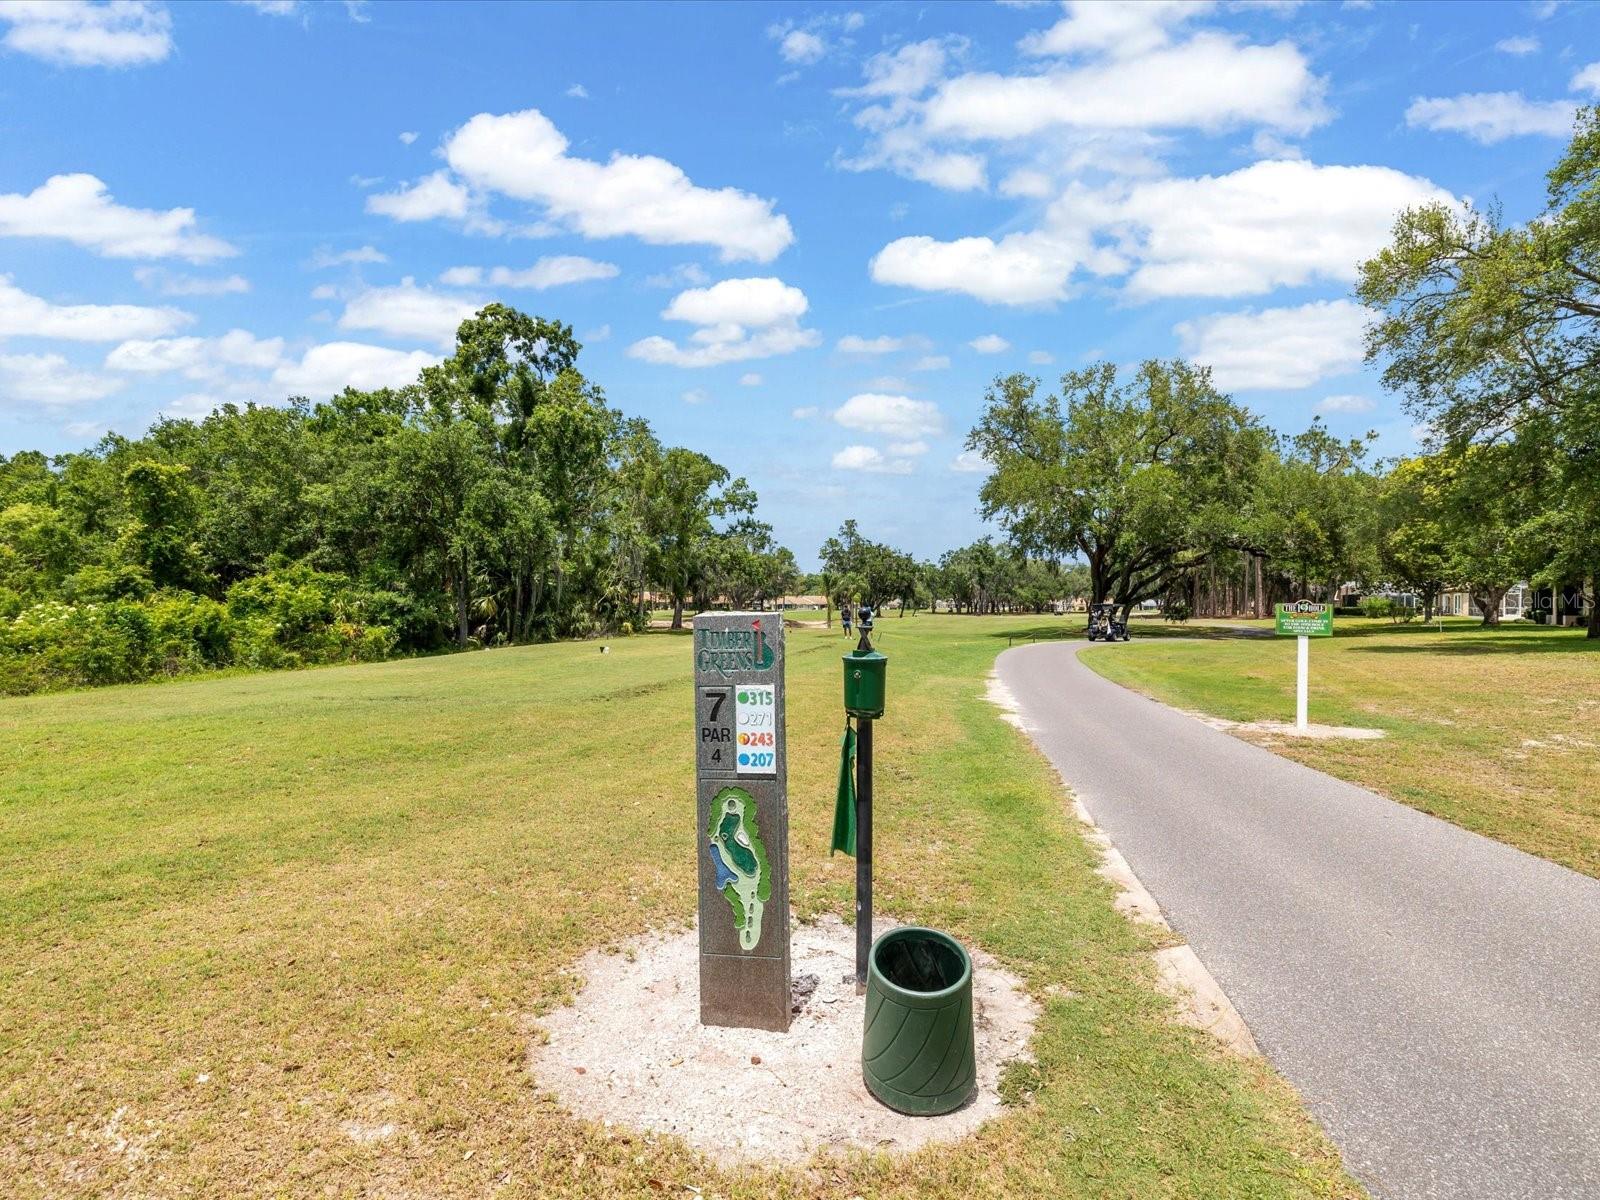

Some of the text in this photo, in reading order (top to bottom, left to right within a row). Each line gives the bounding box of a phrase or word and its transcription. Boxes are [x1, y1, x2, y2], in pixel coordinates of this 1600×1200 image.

[696, 629, 751, 649] TIMBER
[697, 650, 752, 677] GREENS
[749, 692, 773, 705] 315
[705, 693, 726, 722] 7
[749, 711, 772, 726] 271
[702, 728, 731, 742] PAR
[750, 733, 774, 746] 243
[711, 748, 722, 763] 4
[750, 753, 774, 767] 207
